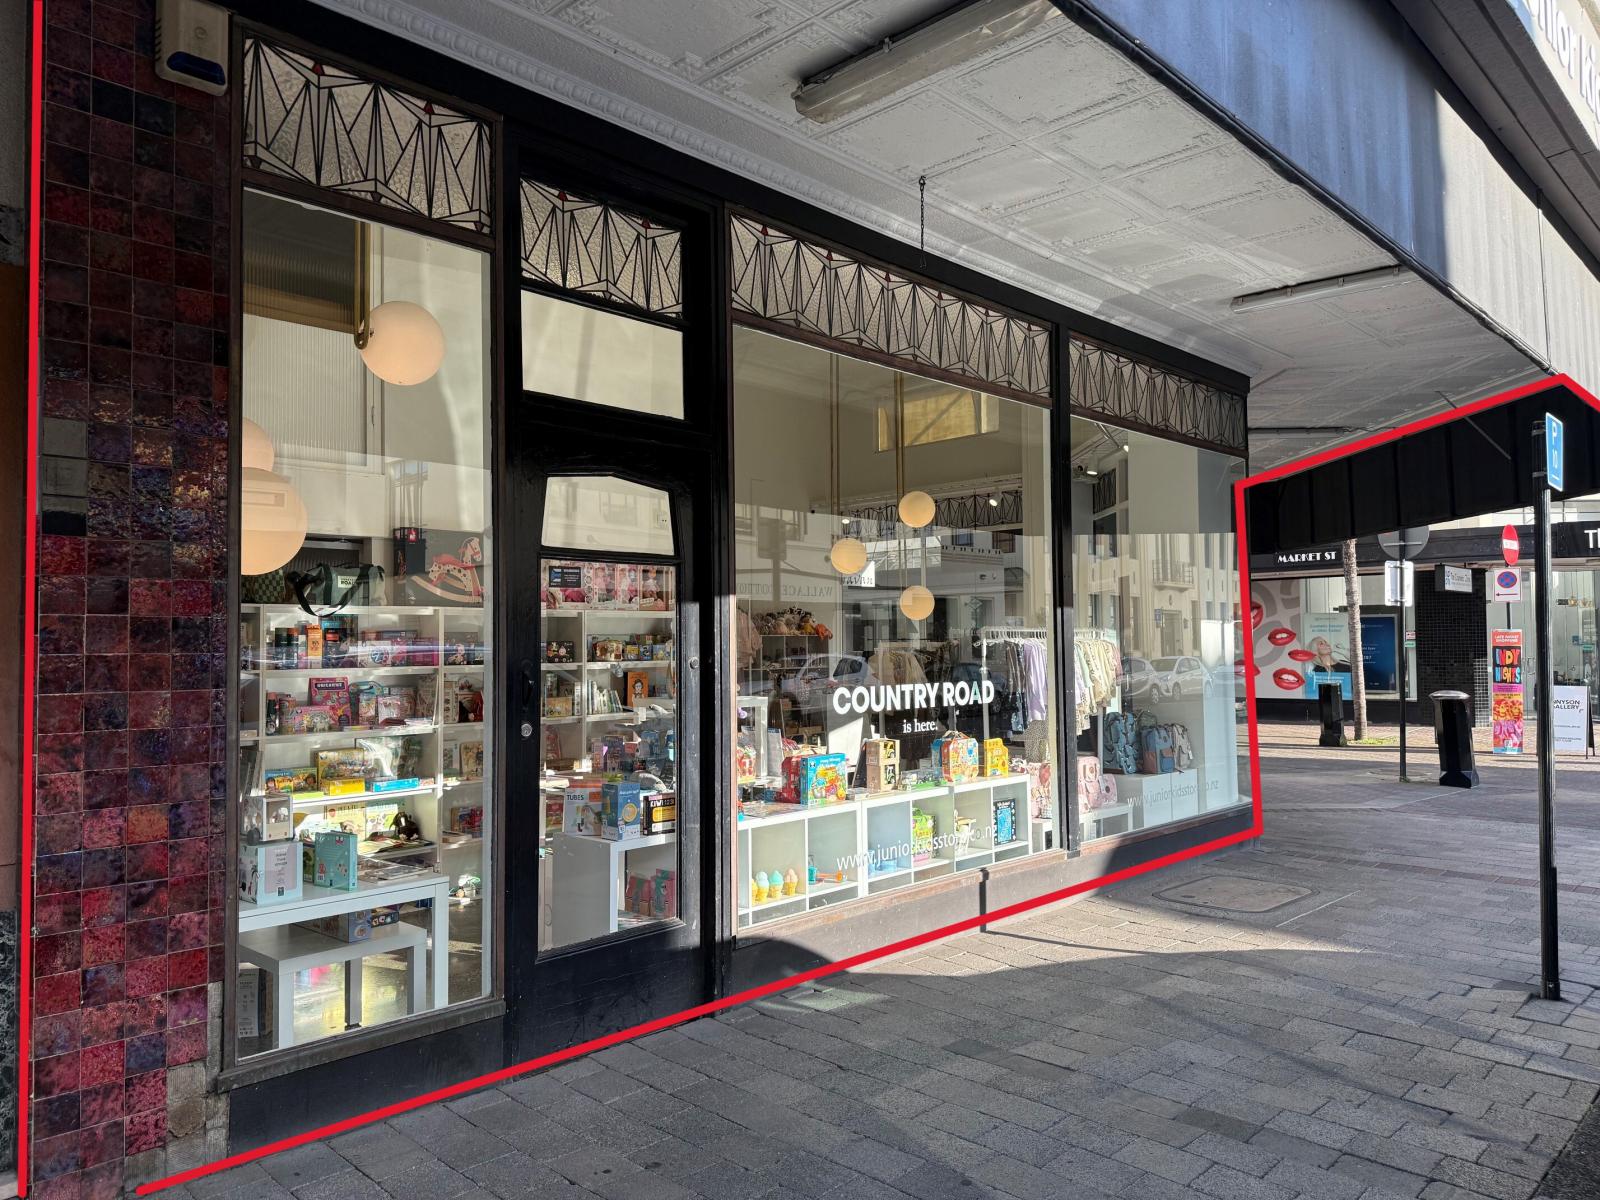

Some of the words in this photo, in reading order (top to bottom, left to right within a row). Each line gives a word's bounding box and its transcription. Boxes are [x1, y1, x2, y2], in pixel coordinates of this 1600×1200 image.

[1584, 527, 1600, 549] T
[1278, 552, 1322, 563] MARKET
[1324, 551, 1337, 560] ST
[1495, 648, 1520, 666] INDY
[1495, 667, 1521, 683] NIGHTS
[833, 683, 940, 714] COUNTRY
[942, 680, 995, 706] ROAD
[903, 719, 912, 733] is
[914, 717, 938, 732] here.
